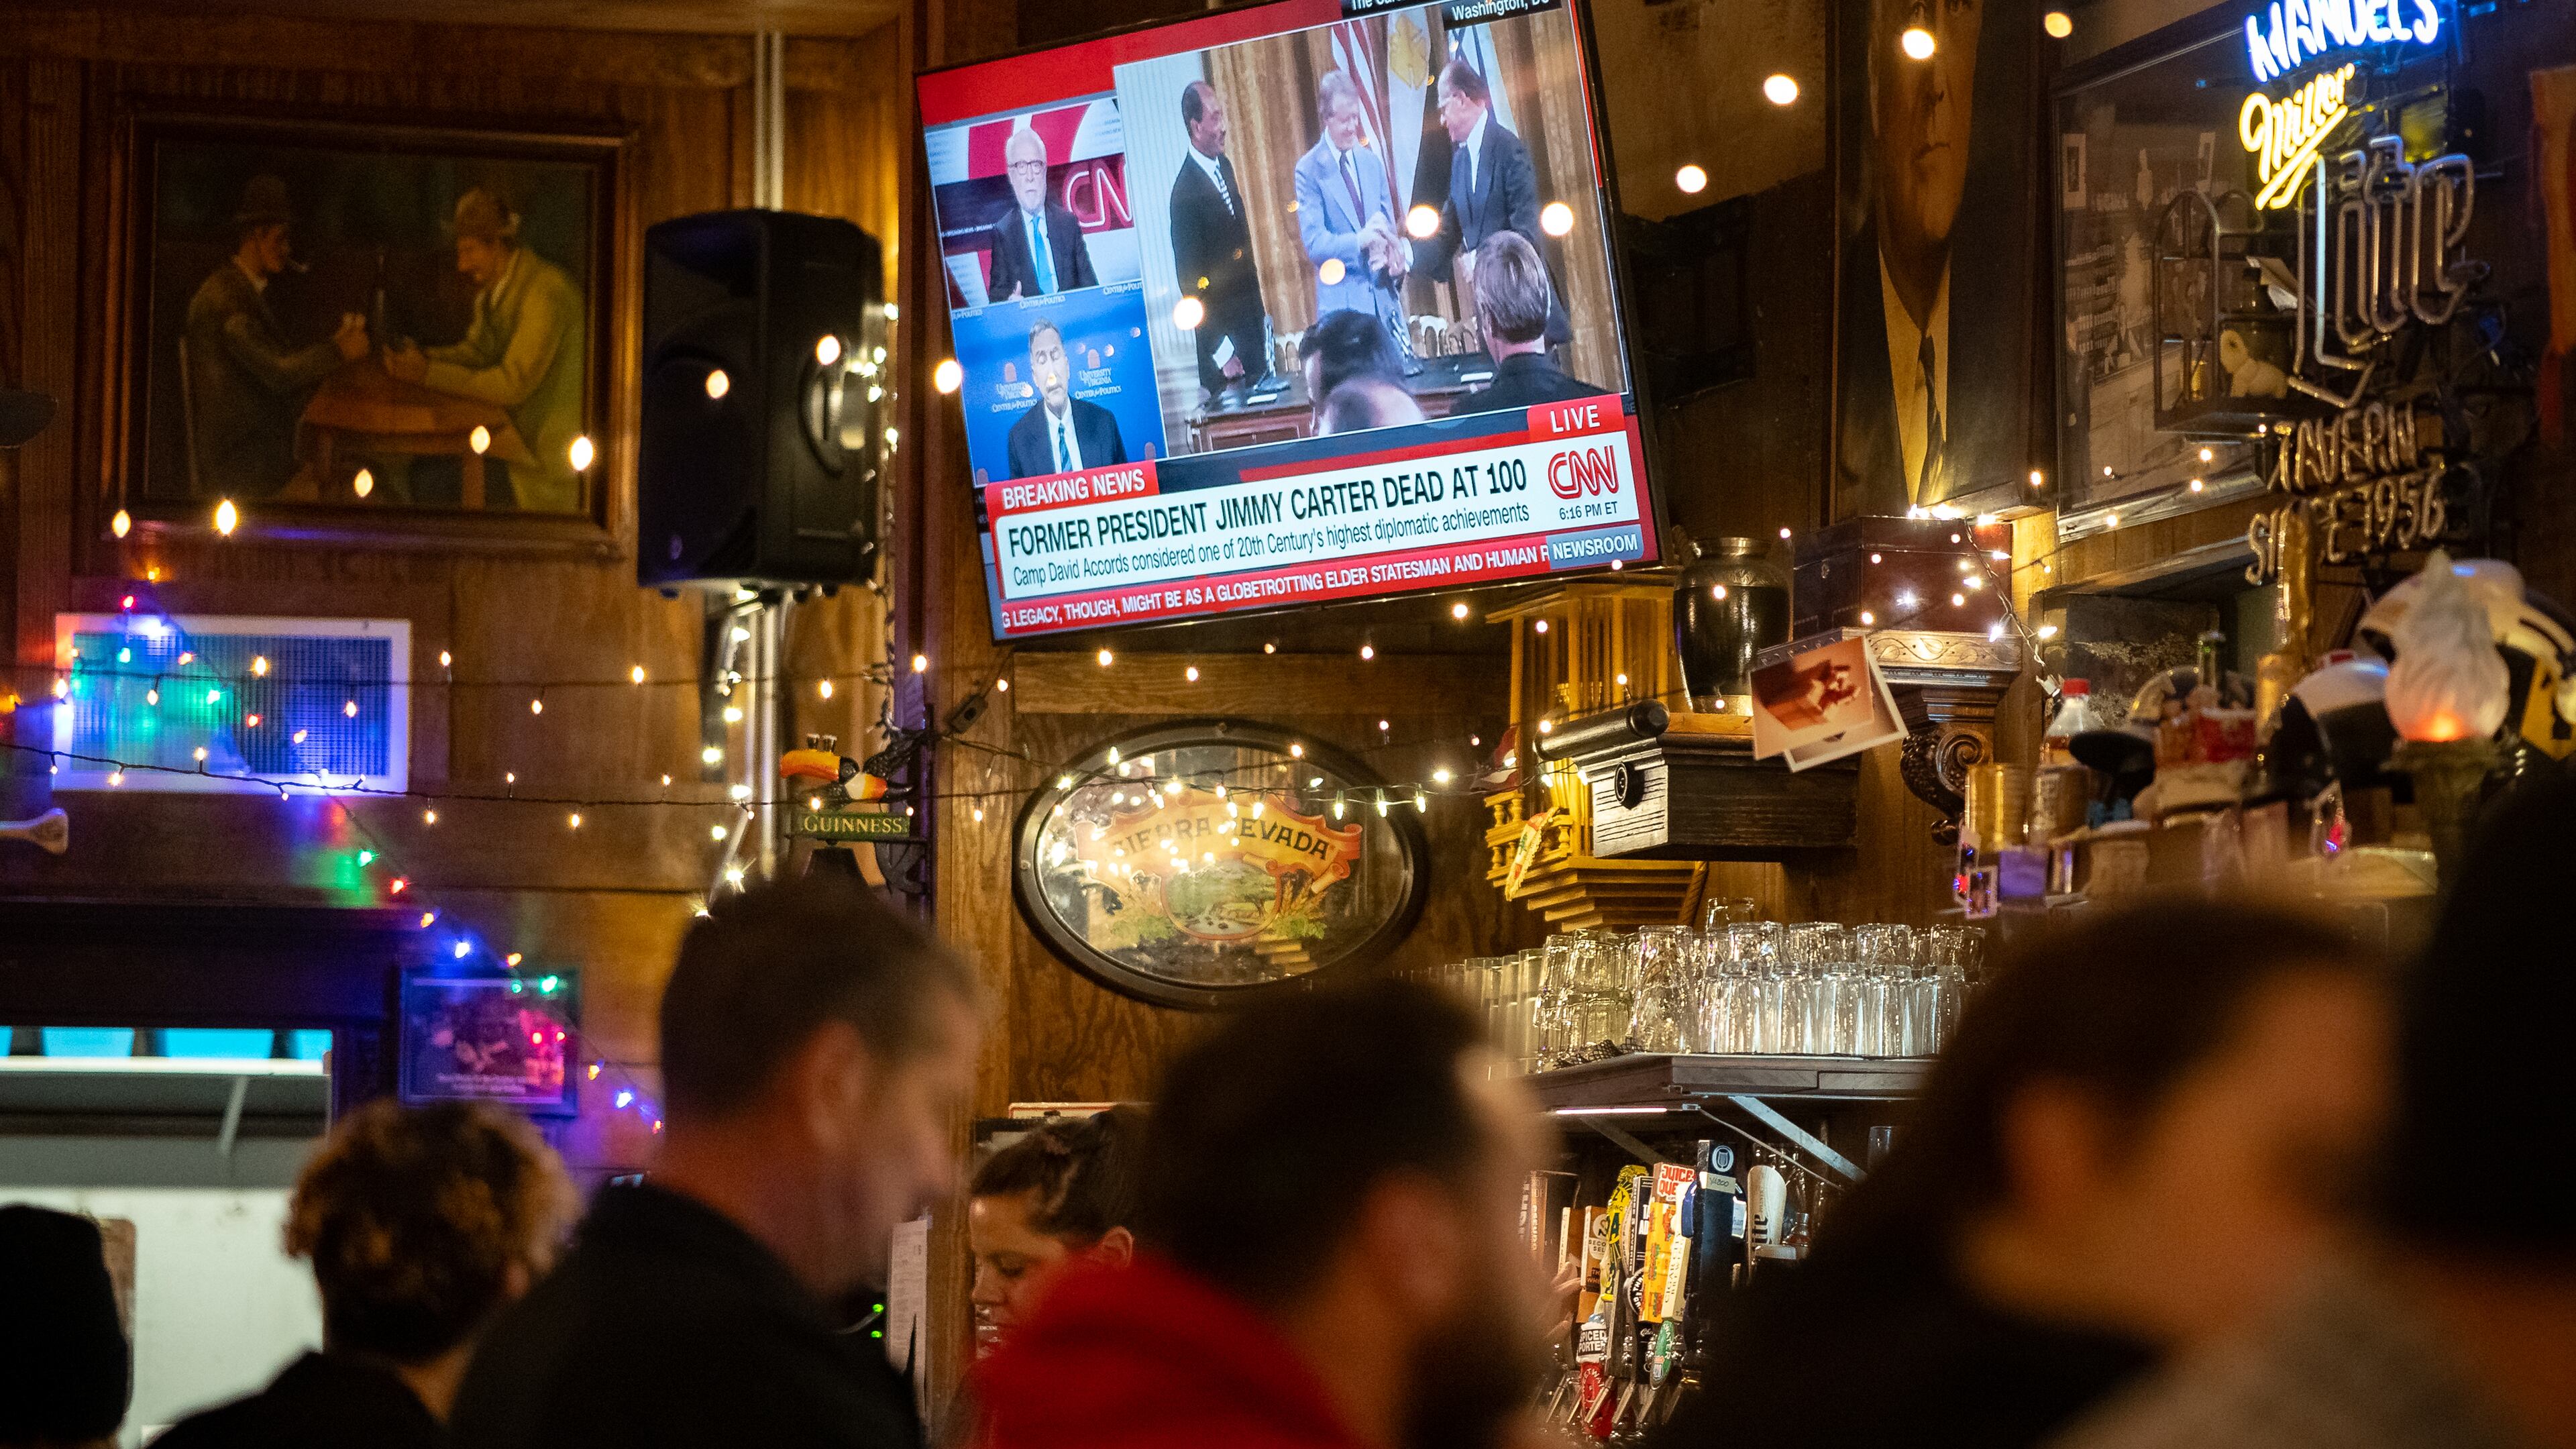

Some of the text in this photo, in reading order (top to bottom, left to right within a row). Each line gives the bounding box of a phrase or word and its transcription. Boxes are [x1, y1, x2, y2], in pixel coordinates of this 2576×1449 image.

[1452, 0, 1529, 21] Washington,
[2239, 62, 2356, 186] Miller
[2288, 134, 2478, 409] Lite
[1550, 404, 1601, 433] LIVE
[1002, 476, 1089, 510] BREAKING
[1093, 468, 1146, 496] NEWS
[1548, 445, 1619, 500] CNN
[1009, 458, 1527, 557] FORMER PRESIDENT JIMMY CARTER DEAD AT 100
[1559, 500, 1618, 521] 6:16 PM ET
[2361, 463, 2446, 555] 1956
[1013, 502, 1529, 588] Camp David Accords considered one of 20th Century's highest diplomatic achievements
[1553, 533, 1638, 561] NEWSROOM
[1002, 611, 1011, 629] G
[1012, 604, 1063, 627] LEGACY,
[1063, 598, 1120, 621] THOUGH,
[1122, 592, 1163, 614] MIGHT
[1165, 590, 1183, 608] BE
[1185, 586, 1203, 605] AS
[1205, 584, 1214, 603] A
[1216, 573, 1324, 602] GLOBETROTTING
[1326, 568, 1366, 589] ELDER
[1371, 557, 1451, 582] STATESMAN
[1454, 553, 1483, 574] AND
[1486, 545, 1538, 569] HUMAN
[804, 815, 903, 835] GUINNESS
[1232, 816, 1330, 861] EVADA
[1662, 1165, 1693, 1182] JUICE
[1664, 1263, 1676, 1303] CIGAR
[1579, 1329, 1607, 1342] SPICED
